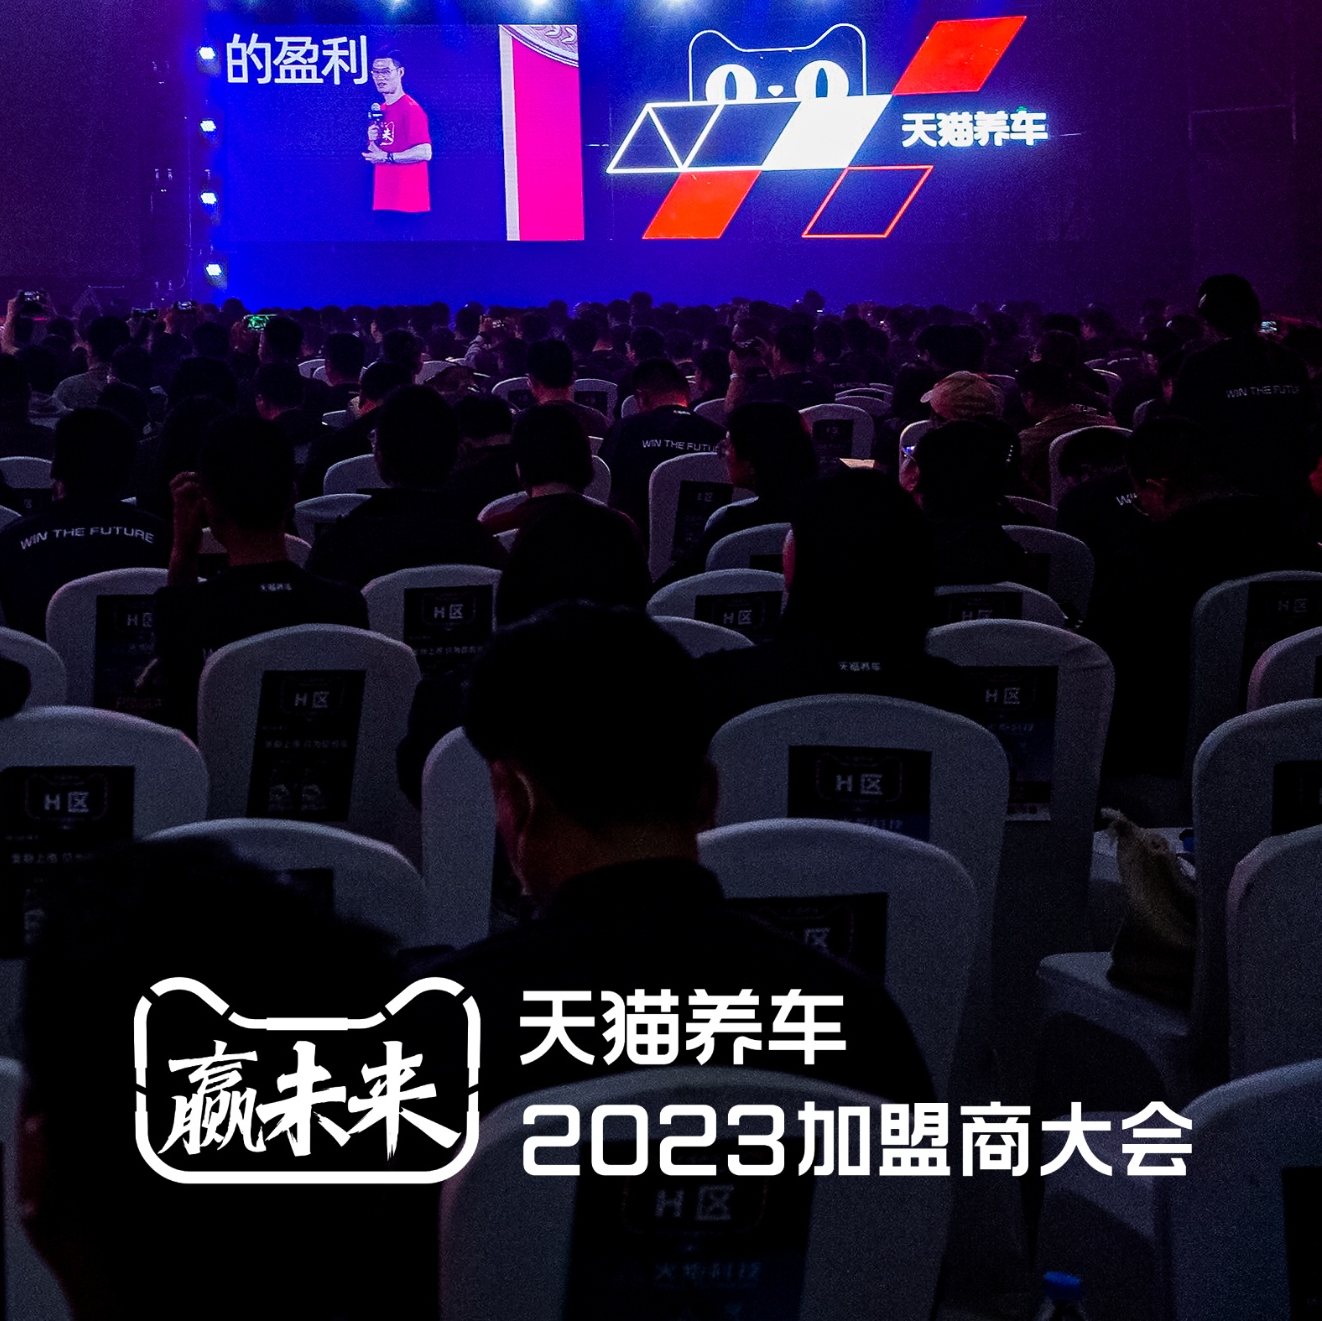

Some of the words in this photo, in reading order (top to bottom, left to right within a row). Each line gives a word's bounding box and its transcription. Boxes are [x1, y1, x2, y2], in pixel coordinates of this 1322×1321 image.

[226, 34, 368, 85] 的盈利
[902, 111, 1048, 149] 天猫养车
[664, 439, 685, 450] THE
[20, 531, 48, 550] WIN
[52, 527, 86, 538] THE
[89, 525, 155, 544] FUTURE
[836, 773, 883, 796] H区
[44, 791, 89, 814] H区
